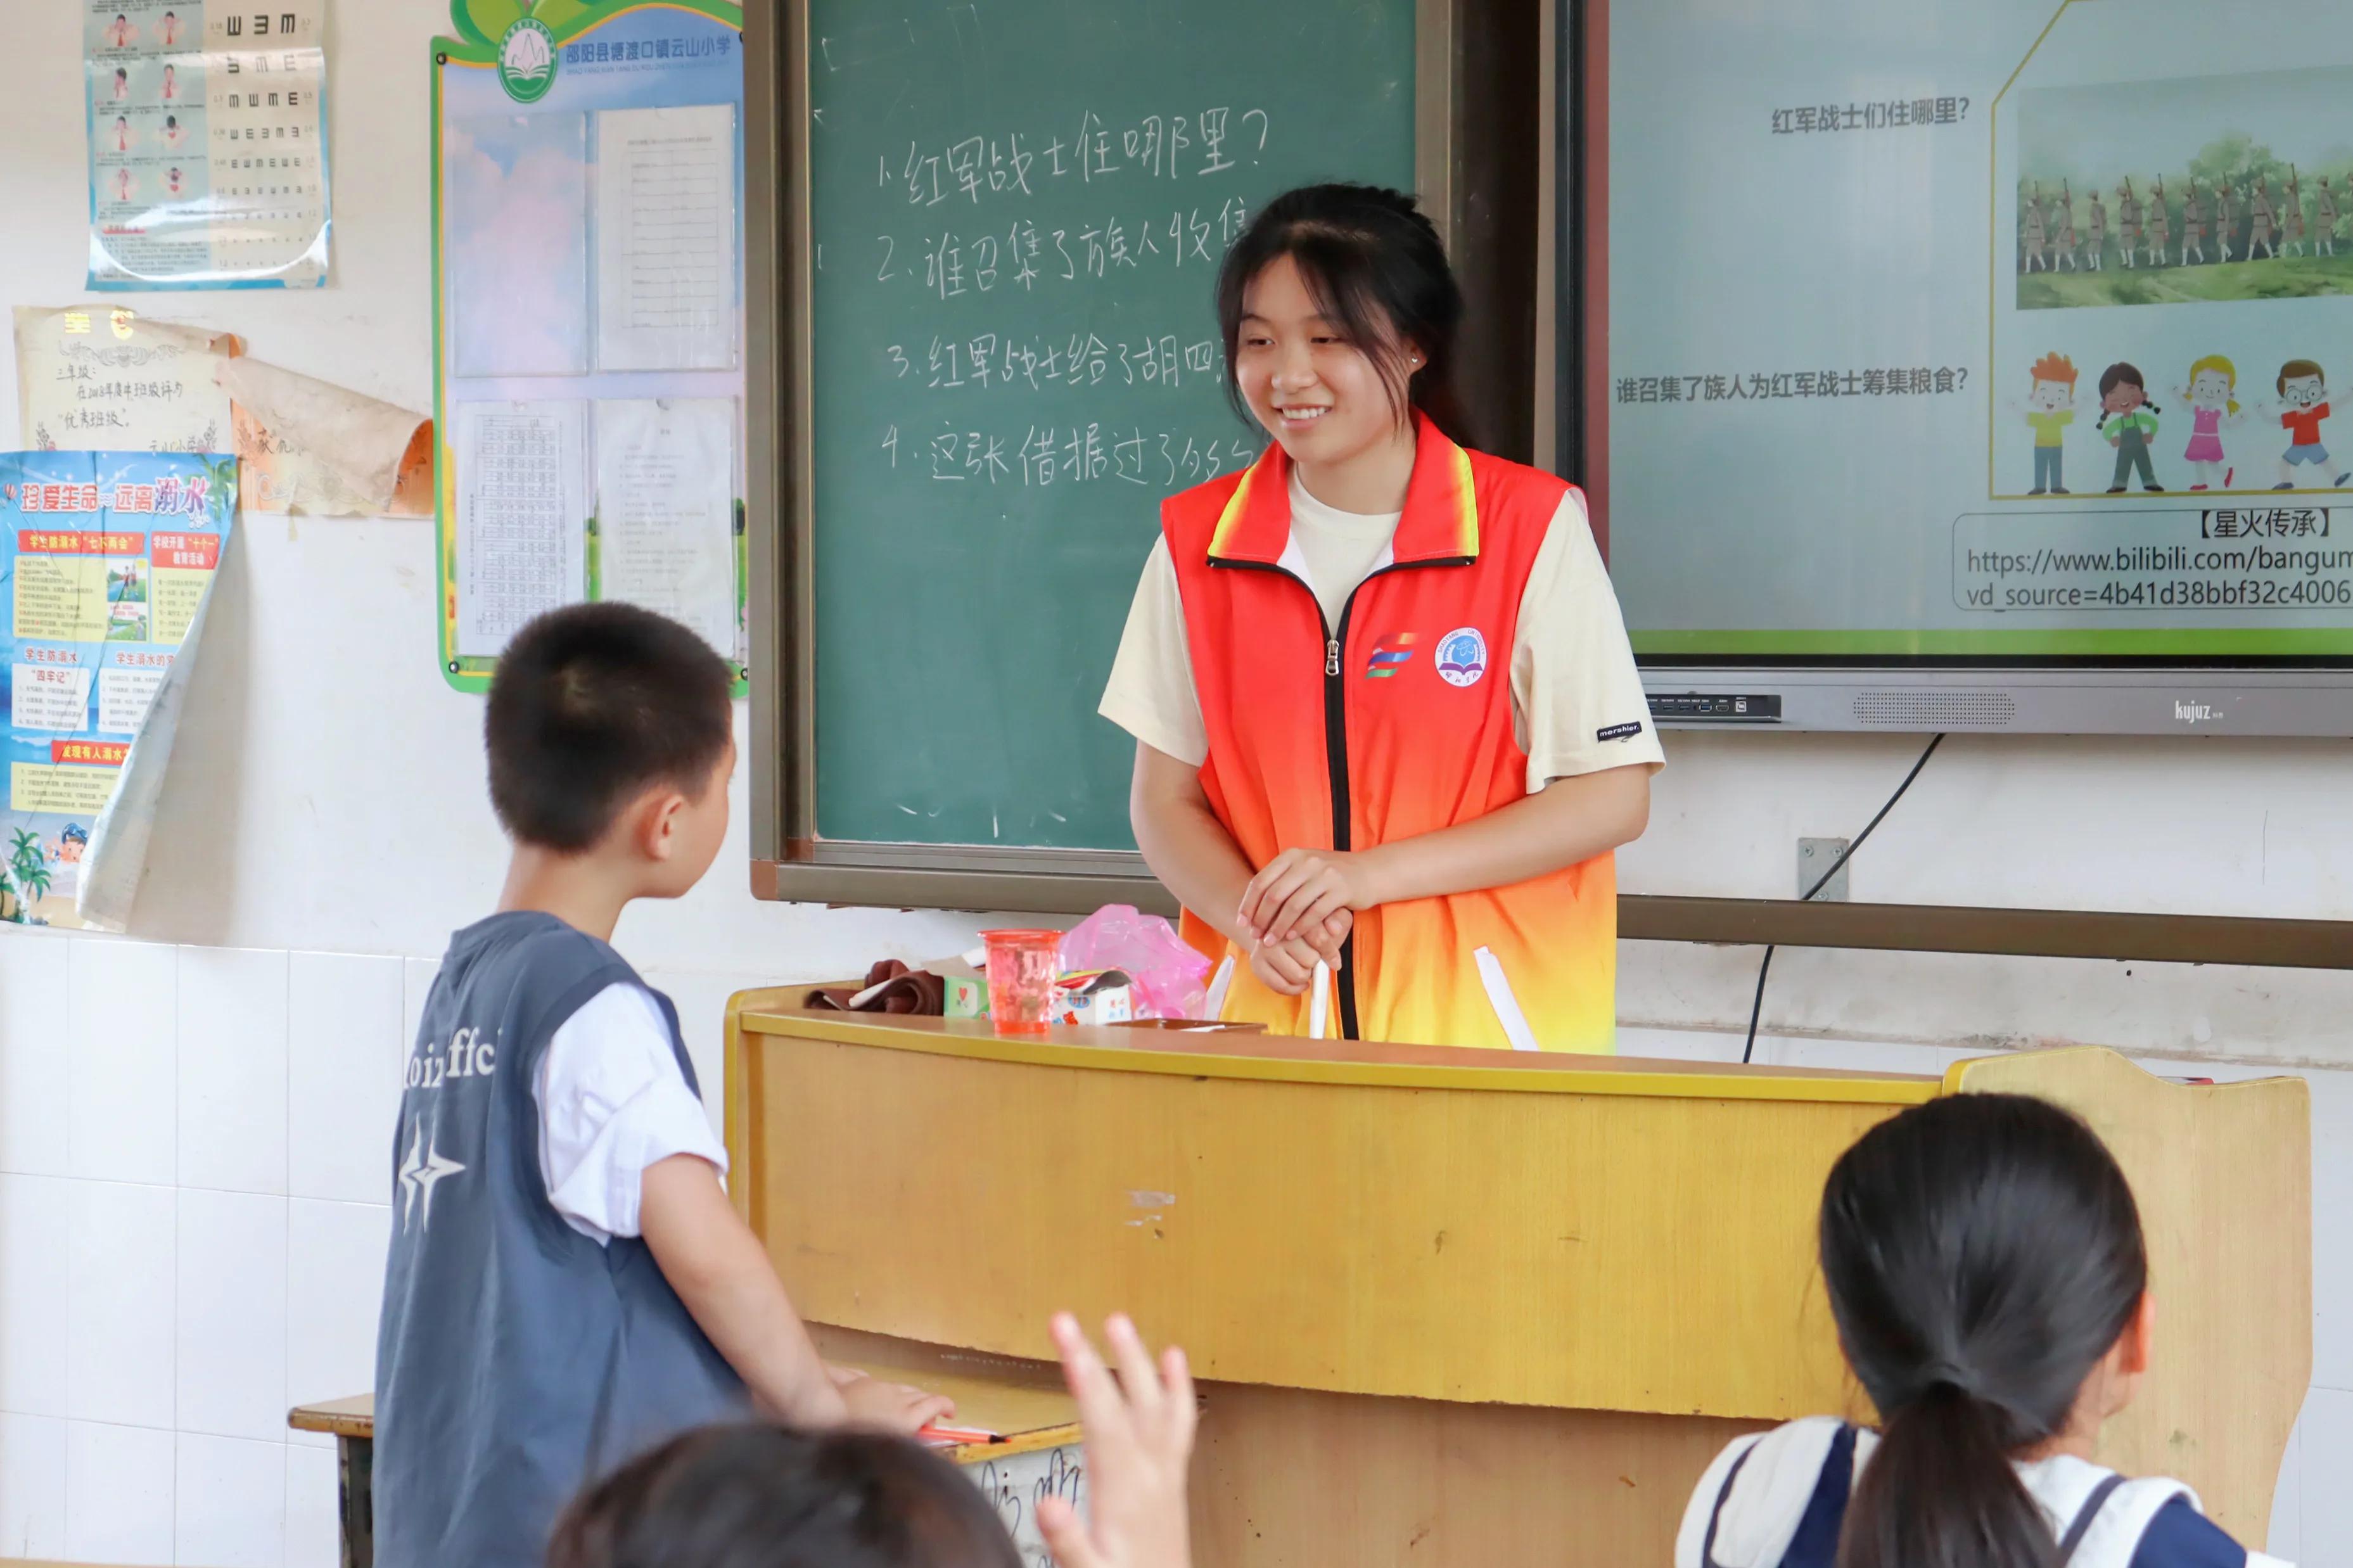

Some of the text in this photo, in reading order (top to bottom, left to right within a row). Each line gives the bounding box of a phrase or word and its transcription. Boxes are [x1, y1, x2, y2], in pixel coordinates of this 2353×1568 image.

[566, 35, 731, 64] 邵阳县塘渡口镇云山小学
[1771, 96, 1970, 135] 红军战士们住哪里？
[1616, 367, 1968, 404] 谁召集了族人为红军战士筹集粮食？
[22, 476, 211, 514] 珍爱生命 远离溺水
[2201, 507, 2330, 539] 【星火传承】
[25, 647, 77, 663] 学生防溺水
[2174, 699, 2211, 723] kujuz
[62, 744, 131, 761] 发现有人溺水
